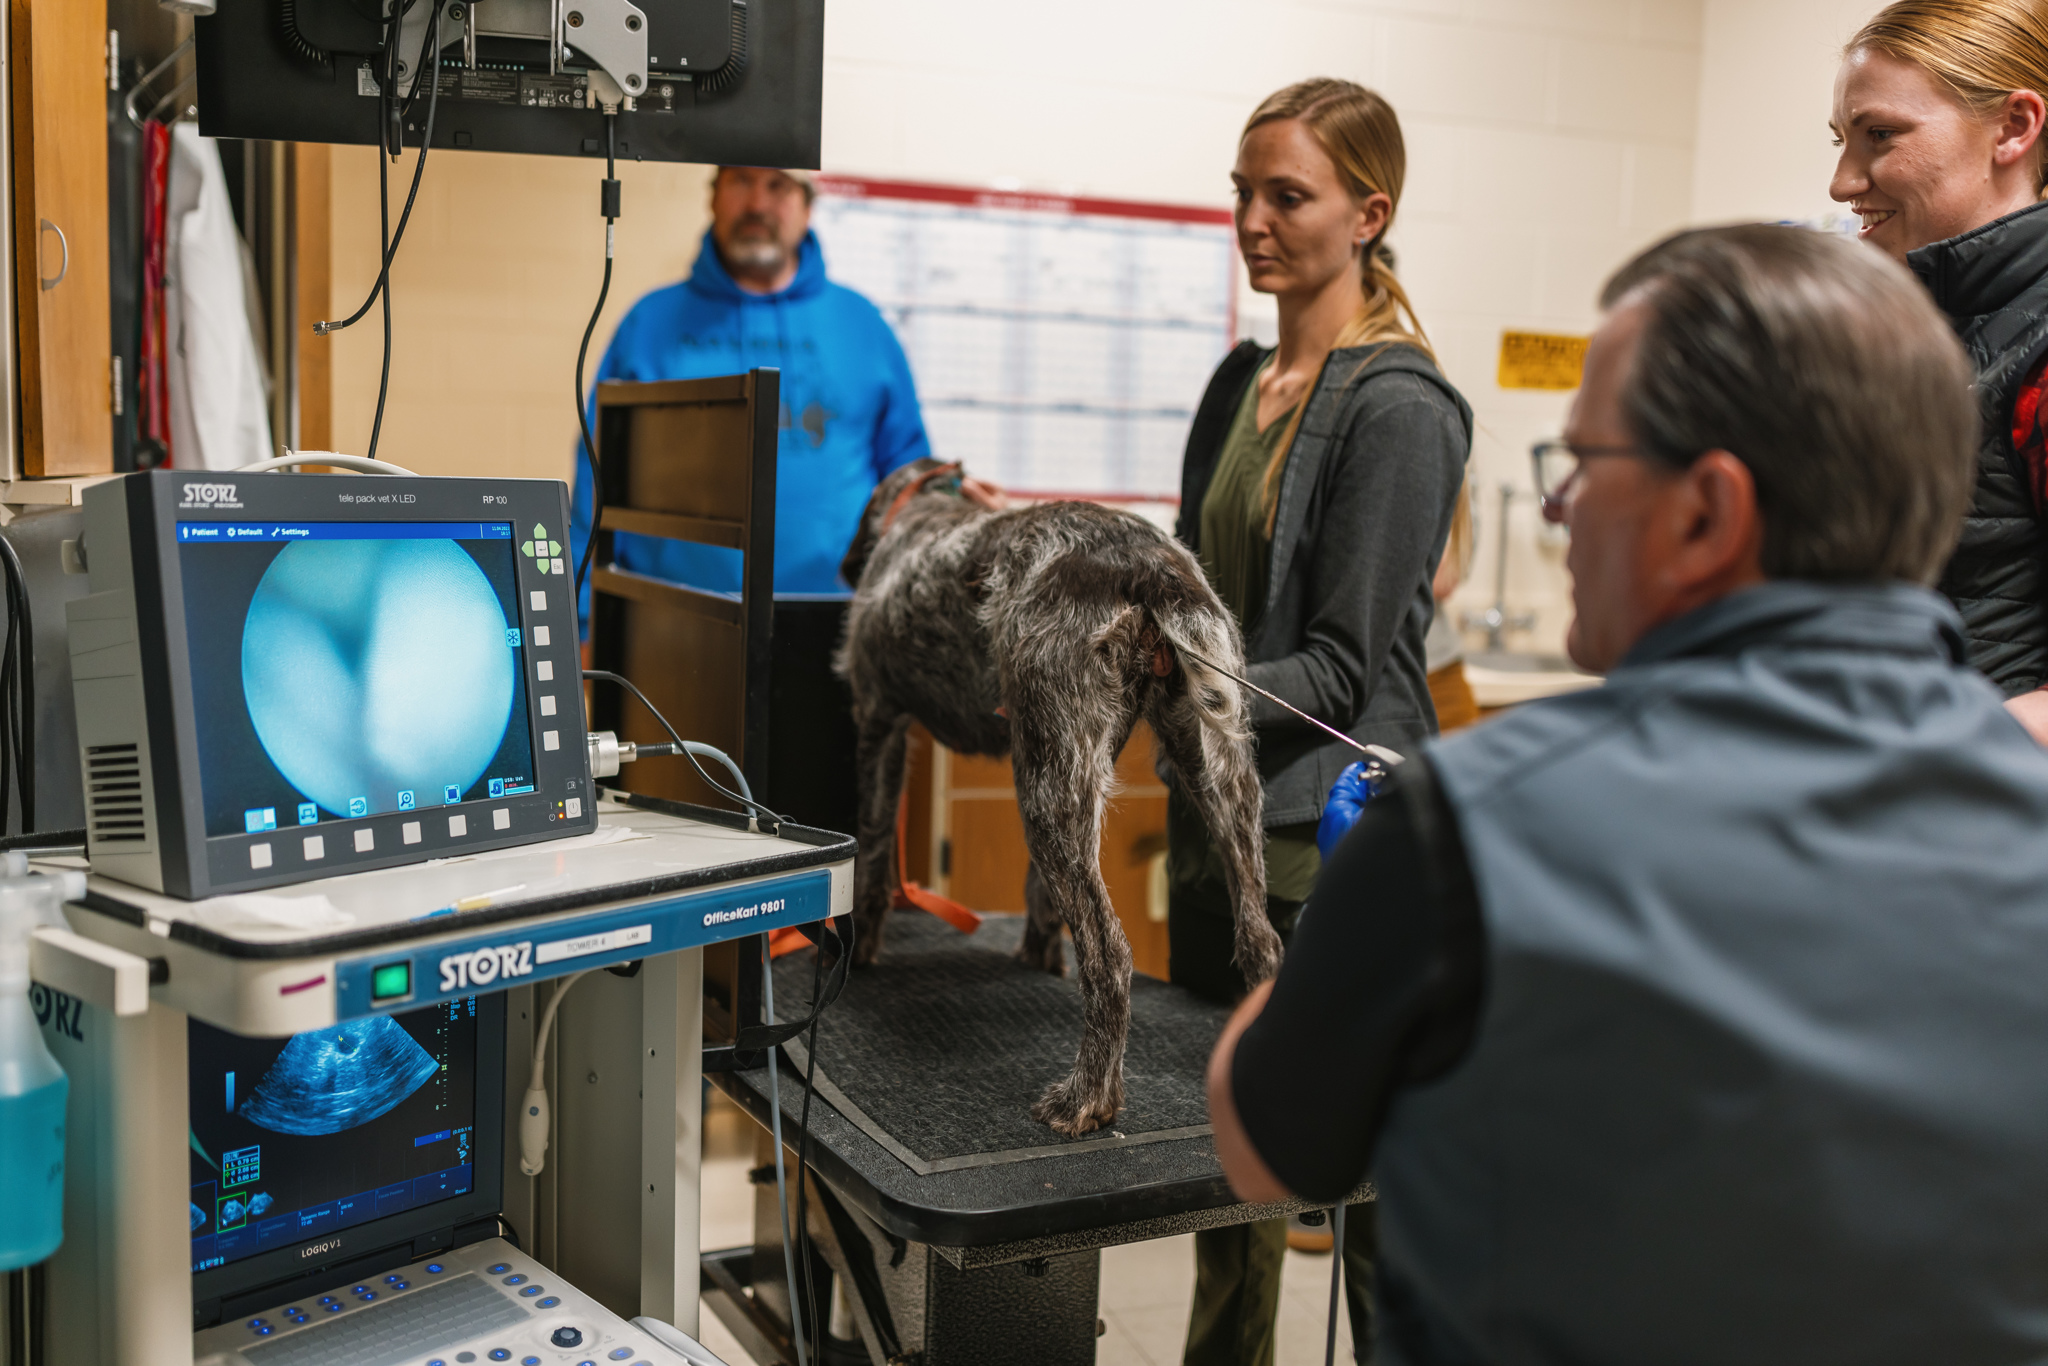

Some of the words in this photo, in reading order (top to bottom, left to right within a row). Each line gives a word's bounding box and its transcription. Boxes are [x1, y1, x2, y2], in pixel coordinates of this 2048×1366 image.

[183, 483, 238, 503] STORZ
[339, 494, 354, 503] tele
[356, 494, 376, 504] pack
[378, 495, 390, 503] vet
[391, 495, 398, 503] X
[399, 494, 416, 503] LED
[483, 496, 494, 504] RP
[496, 496, 508, 504] 100
[192, 528, 219, 537] Patient
[237, 528, 263, 536] Default
[281, 527, 310, 537] Settings
[703, 904, 759, 926] OfficeKart
[760, 898, 785, 915] 9801
[439, 941, 534, 993] STORZ
[301, 1243, 329, 1258] LOGIQ
[330, 1241, 336, 1249] V
